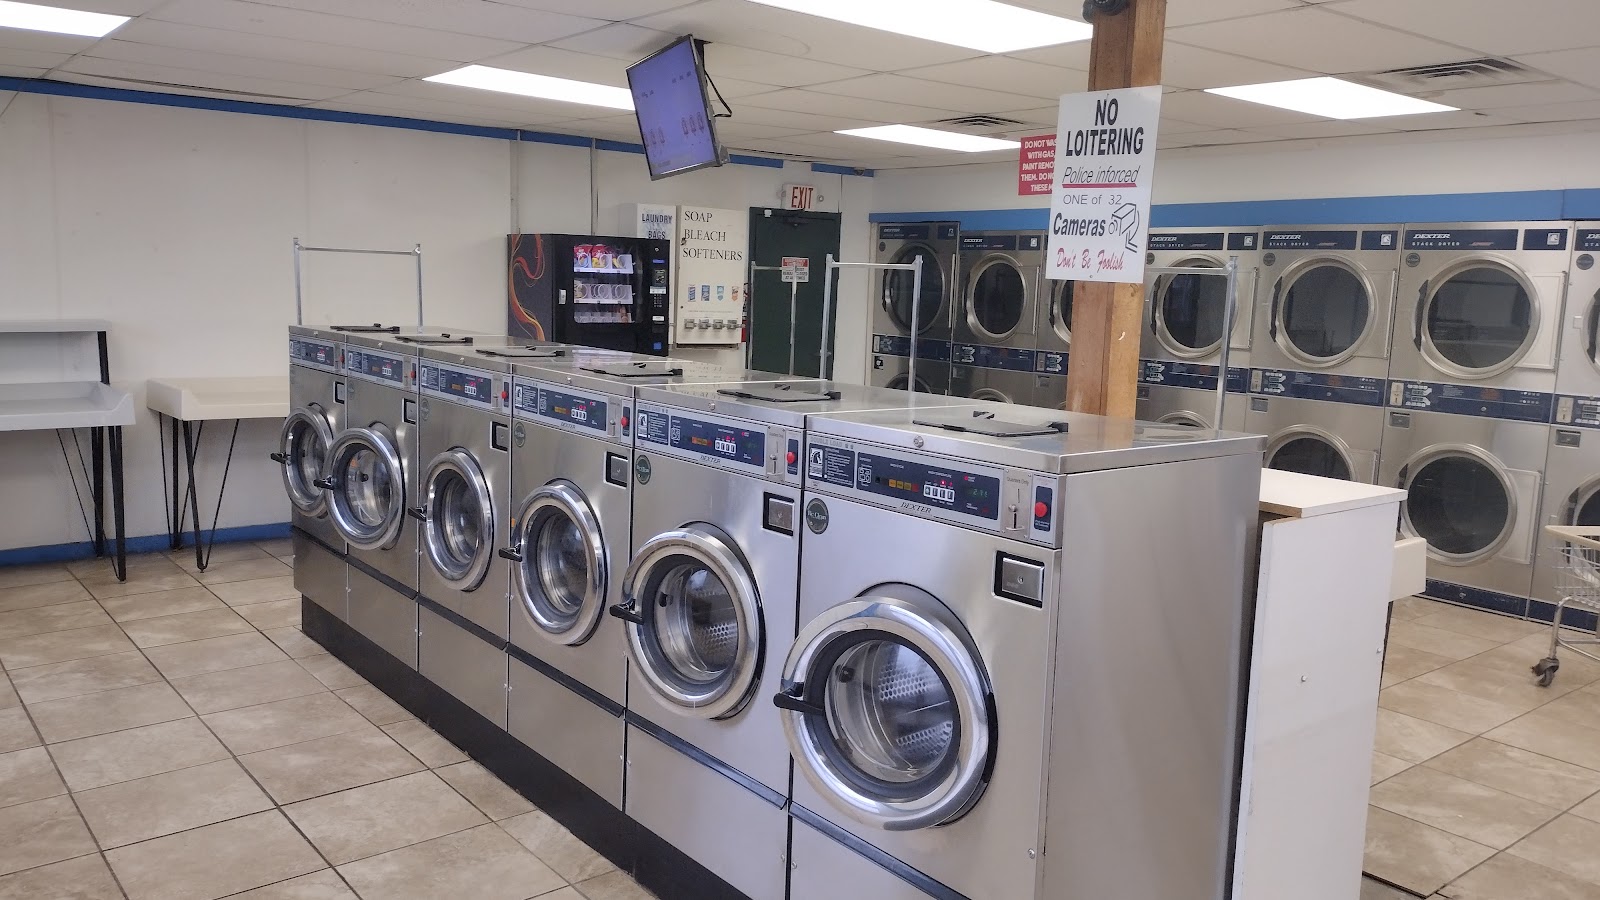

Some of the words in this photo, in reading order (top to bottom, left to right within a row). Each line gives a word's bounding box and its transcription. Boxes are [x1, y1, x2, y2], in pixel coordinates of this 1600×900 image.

[1094, 98, 1119, 126] NO
[1024, 141, 1033, 149] DO
[1033, 140, 1045, 148] NOT
[1066, 127, 1144, 157] LOITERING
[1027, 151, 1042, 159] WITH
[1022, 163, 1038, 171] PAINT
[1038, 172, 1048, 181] DO
[1063, 166, 1094, 184] Police
[1095, 165, 1140, 183] inforced
[1030, 184, 1048, 192] THESE
[791, 186, 814, 210] EXIT
[1063, 194, 1088, 205] ONE
[1091, 194, 1102, 205] of
[1108, 194, 1122, 205] 32
[641, 213, 673, 224] LAUNDRY
[684, 210, 713, 223] SOAP
[1053, 212, 1106, 237] Cameras
[647, 230, 666, 240] BAGS
[684, 228, 727, 242] BLEACH
[682, 247, 743, 262] SOFTENERS
[1056, 247, 1076, 269] Don't
[1081, 248, 1092, 269] Be
[1097, 249, 1124, 273] Foolish
[900, 501, 933, 514] DEXTER
